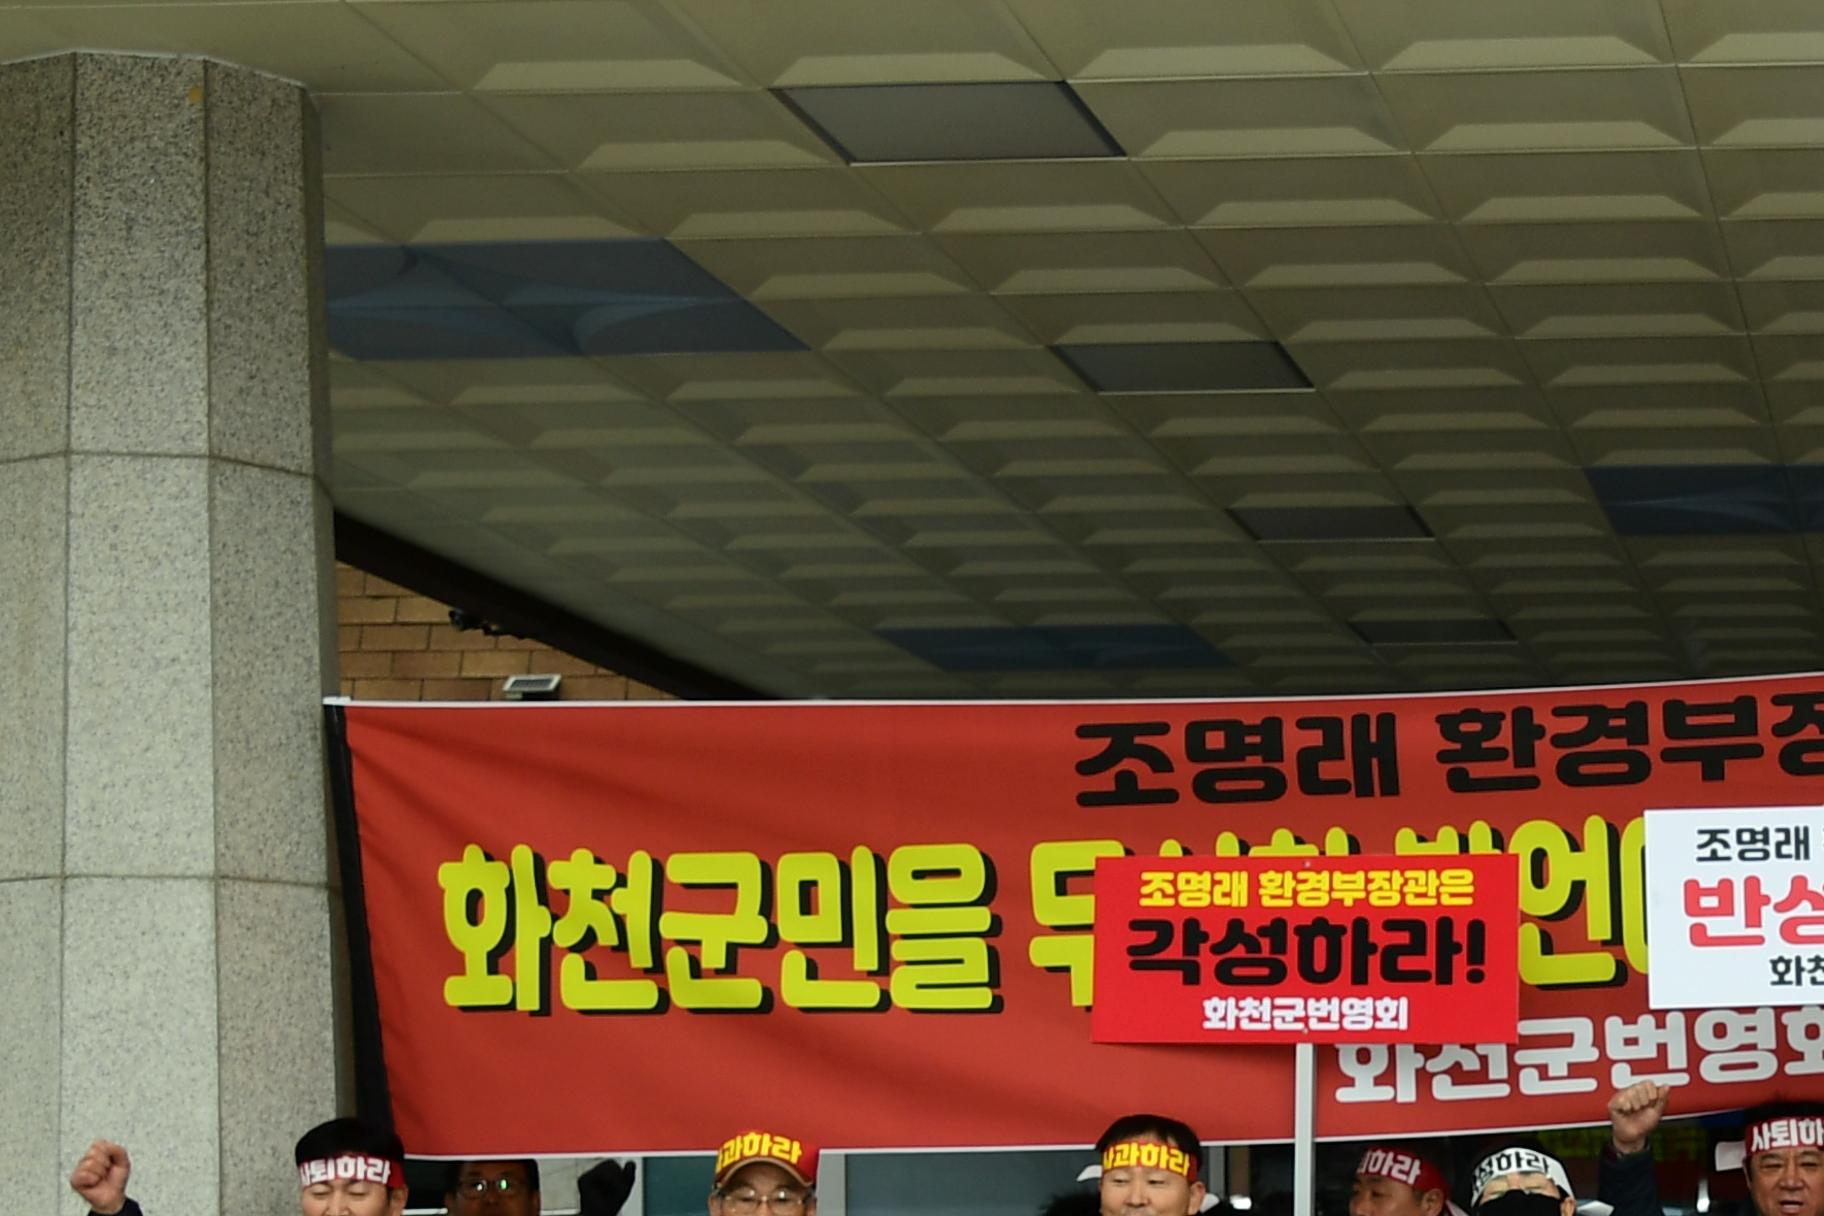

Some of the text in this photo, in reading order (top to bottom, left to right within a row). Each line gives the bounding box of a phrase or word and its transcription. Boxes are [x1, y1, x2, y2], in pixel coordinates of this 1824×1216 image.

[1075, 712, 1400, 808] 조명래
[1696, 826, 1809, 861] 조명래
[1140, 869, 1474, 907] 조명래 환경부장관은
[437, 843, 996, 1012] 화천군민을
[1126, 916, 1485, 986] 각성하라!
[1203, 997, 1409, 1032] 화천군번영회
